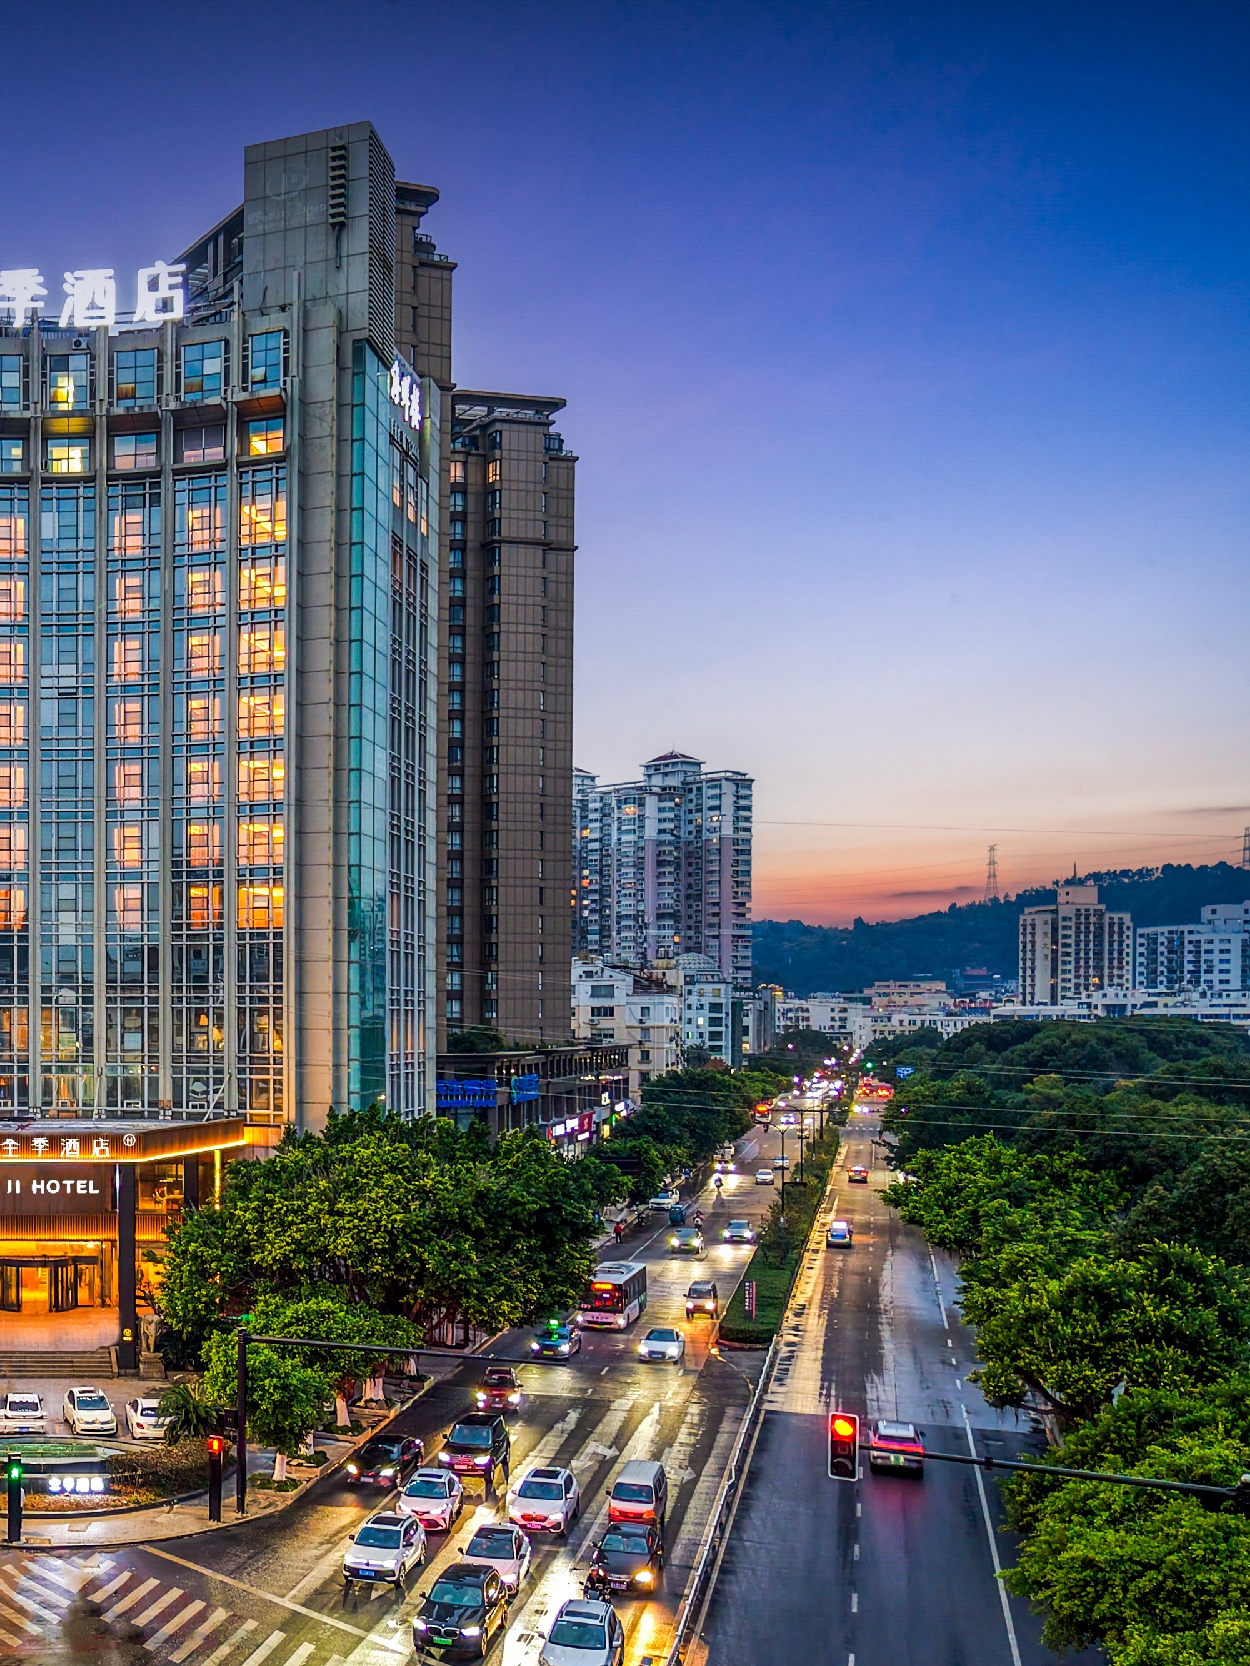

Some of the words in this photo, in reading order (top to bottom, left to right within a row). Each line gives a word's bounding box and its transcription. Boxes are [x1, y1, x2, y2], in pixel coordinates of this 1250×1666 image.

[0, 1137, 110, 1158] 全季酒店
[7, 1179, 21, 1194] JI
[31, 1179, 100, 1194] HOTEL
